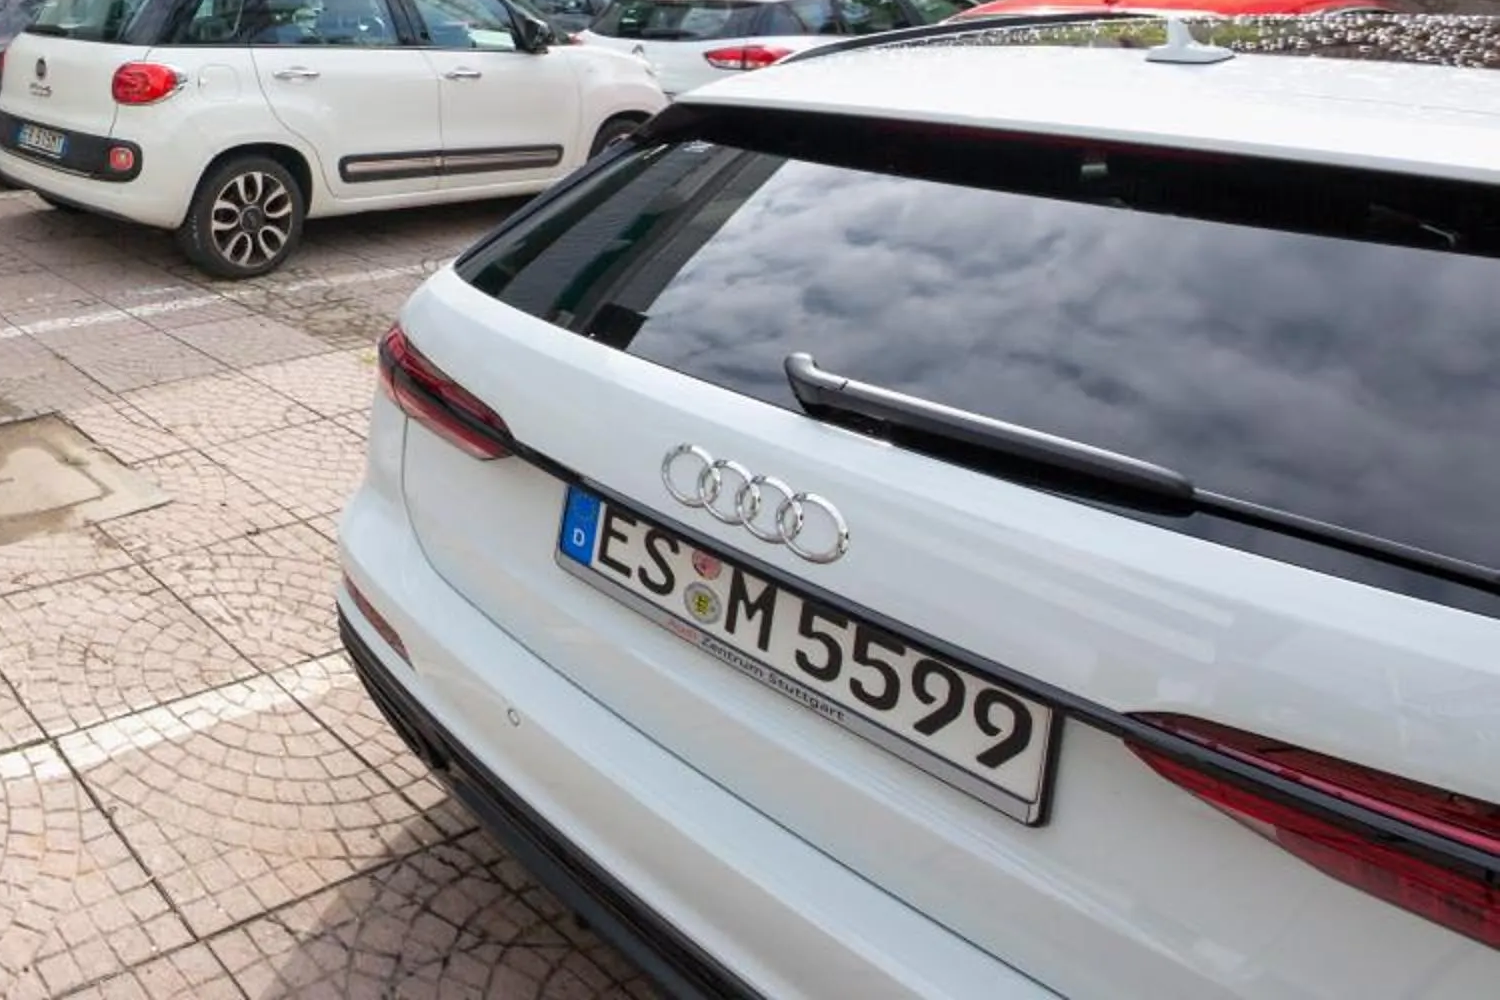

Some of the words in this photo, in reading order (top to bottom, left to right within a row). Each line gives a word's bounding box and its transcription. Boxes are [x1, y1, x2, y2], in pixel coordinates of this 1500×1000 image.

[572, 528, 585, 547] D
[598, 502, 681, 595] ES
[724, 567, 777, 652] M
[795, 600, 1033, 769] 5599
[701, 633, 764, 679] Zentrum
[767, 672, 846, 722] Stuttgart
